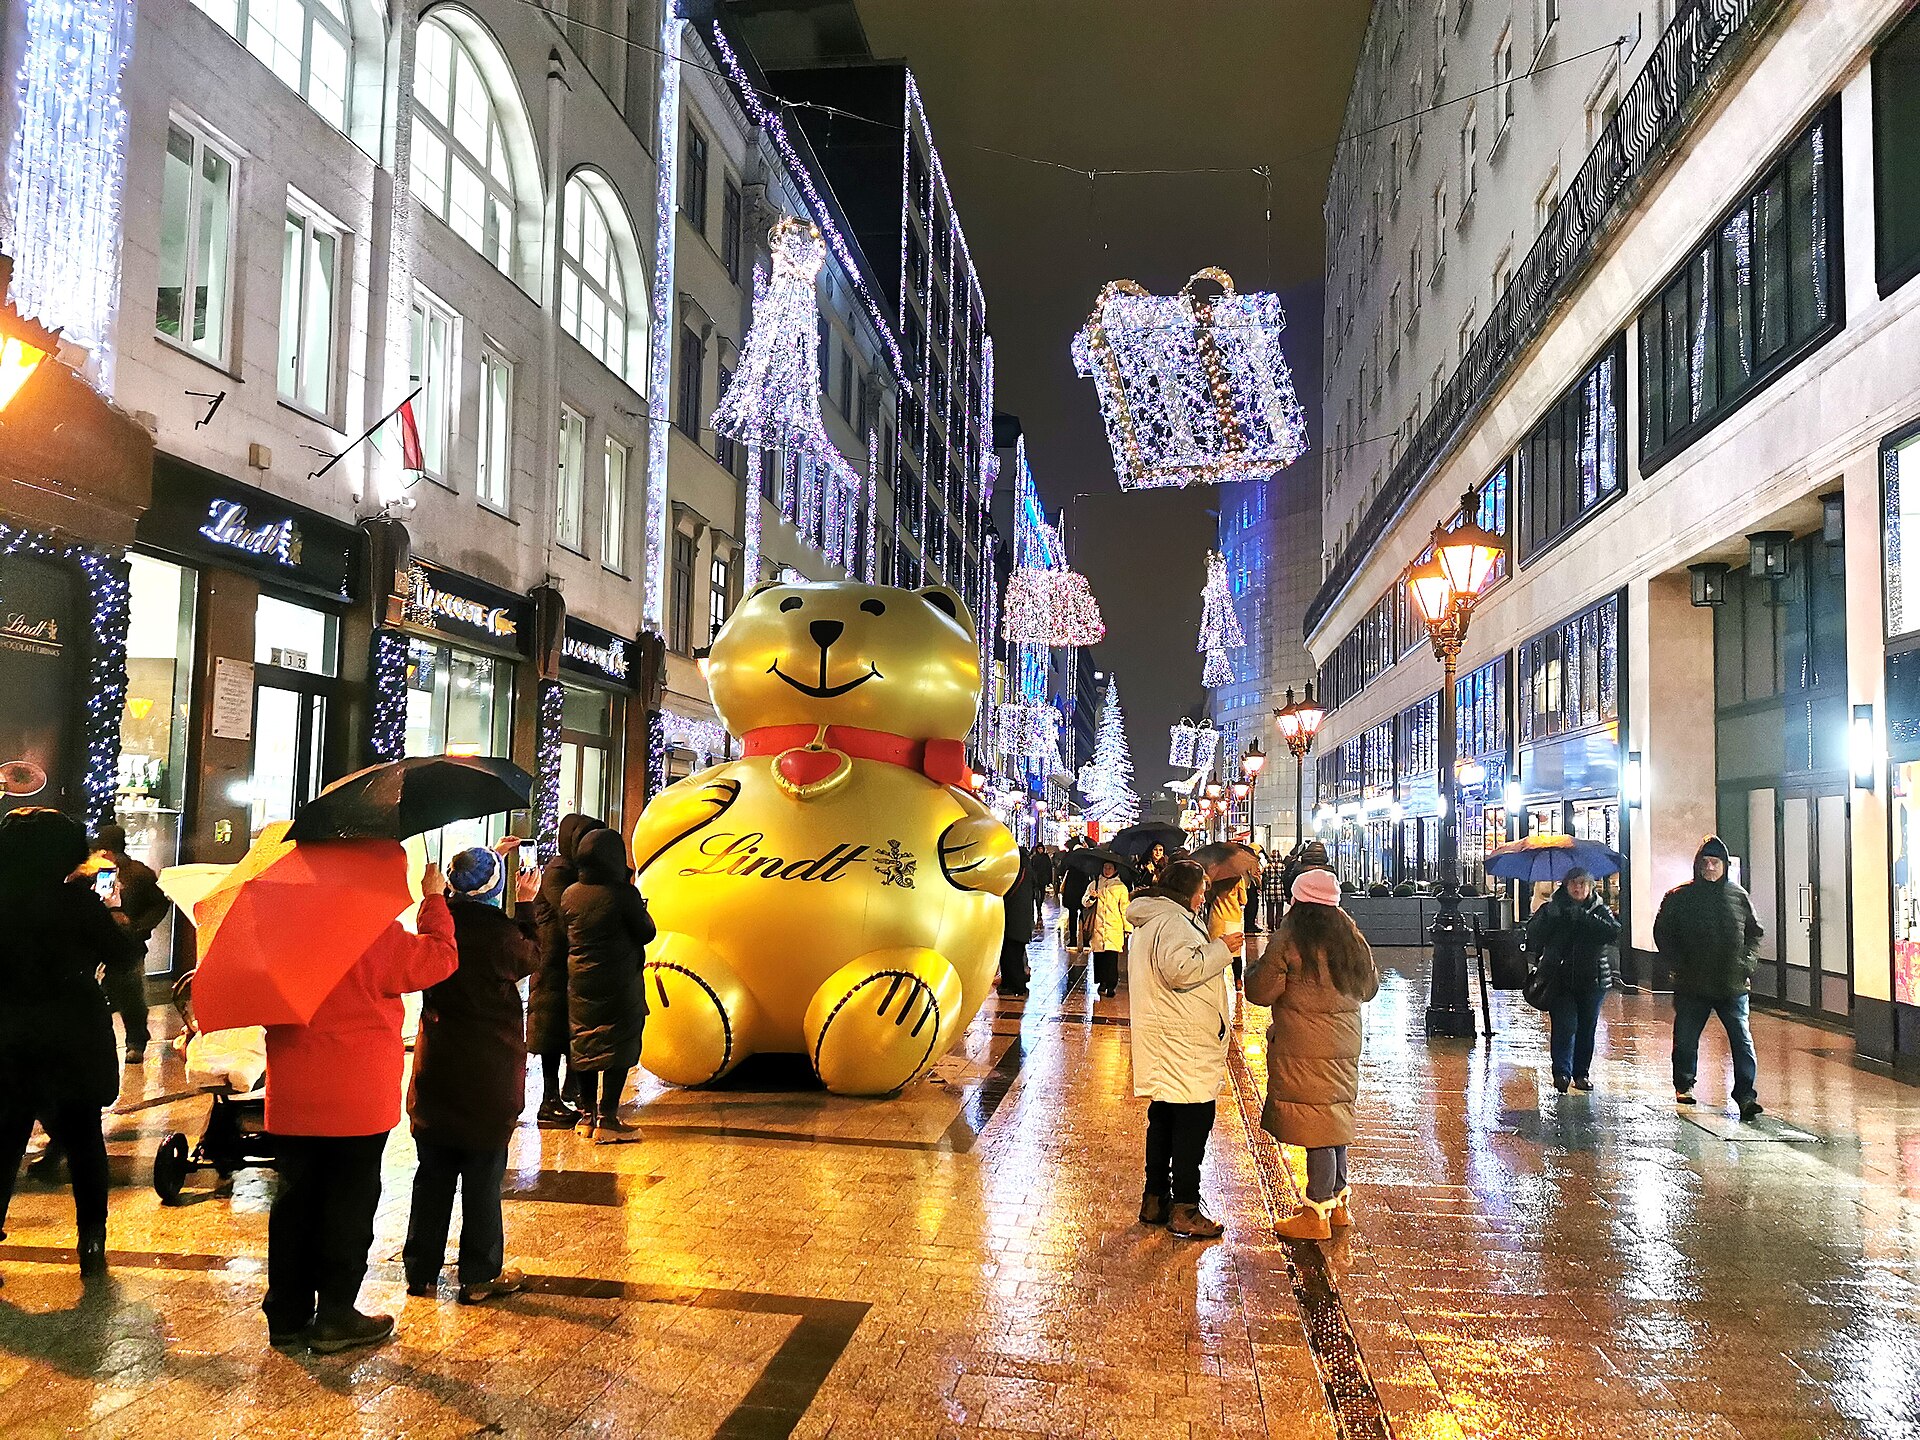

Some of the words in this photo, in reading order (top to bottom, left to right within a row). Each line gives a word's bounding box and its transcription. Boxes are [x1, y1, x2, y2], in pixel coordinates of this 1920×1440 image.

[199, 499, 284, 555] Lindt
[2, 612, 47, 637] Lindt
[678, 832, 870, 883] Lindt
